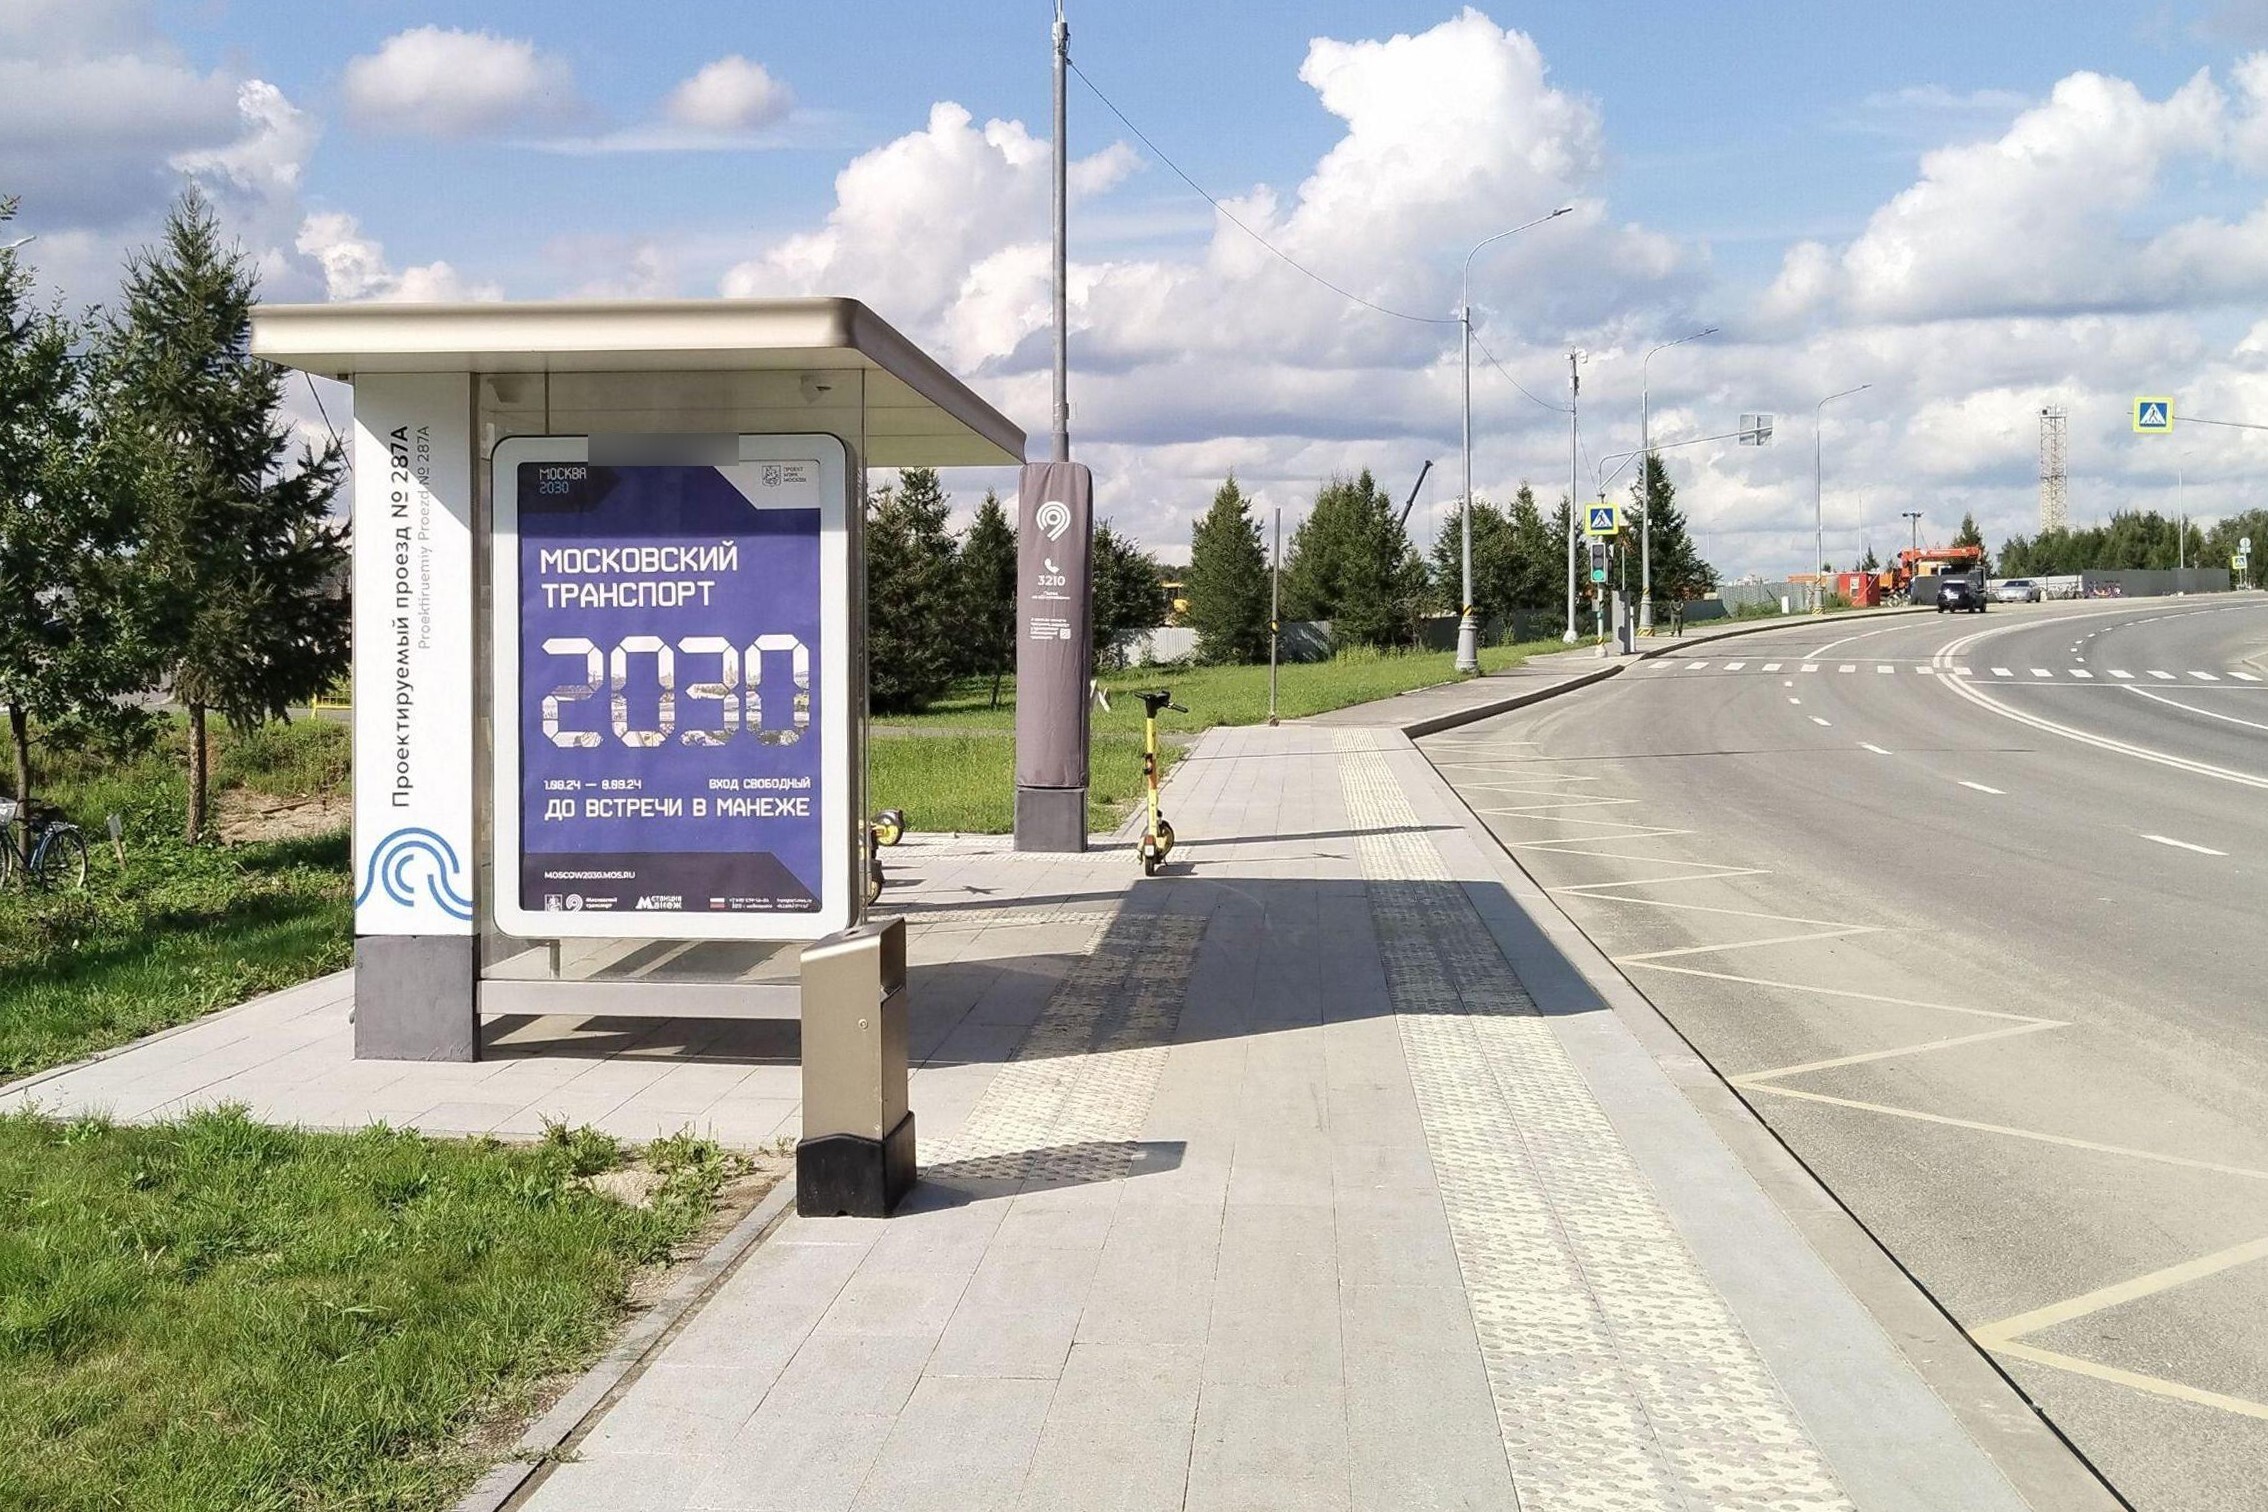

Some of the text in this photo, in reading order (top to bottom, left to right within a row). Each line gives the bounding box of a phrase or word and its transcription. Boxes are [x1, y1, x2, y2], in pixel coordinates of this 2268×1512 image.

[539, 466, 588, 480] МОСКВА
[539, 481, 570, 494] 2030
[391, 490, 409, 518] №
[417, 426, 432, 649] Proektiruemiy Proezd № 287A
[396, 526, 413, 608] проезд
[540, 540, 738, 574] МОСКОВСКИЙ
[1037, 575, 1066, 586] 3210
[541, 581, 716, 608] ТРАНСПОРТ
[541, 634, 810, 748] 2030
[392, 617, 413, 807] Проектируемый
[709, 776, 811, 791] ВХОД СВОБОДНЫЙ
[544, 797, 811, 821] ДО ВСТРЕЧИ В МАНЕЖЕ
[544, 871, 636, 879] MOSCOW2030.MOS.RU
